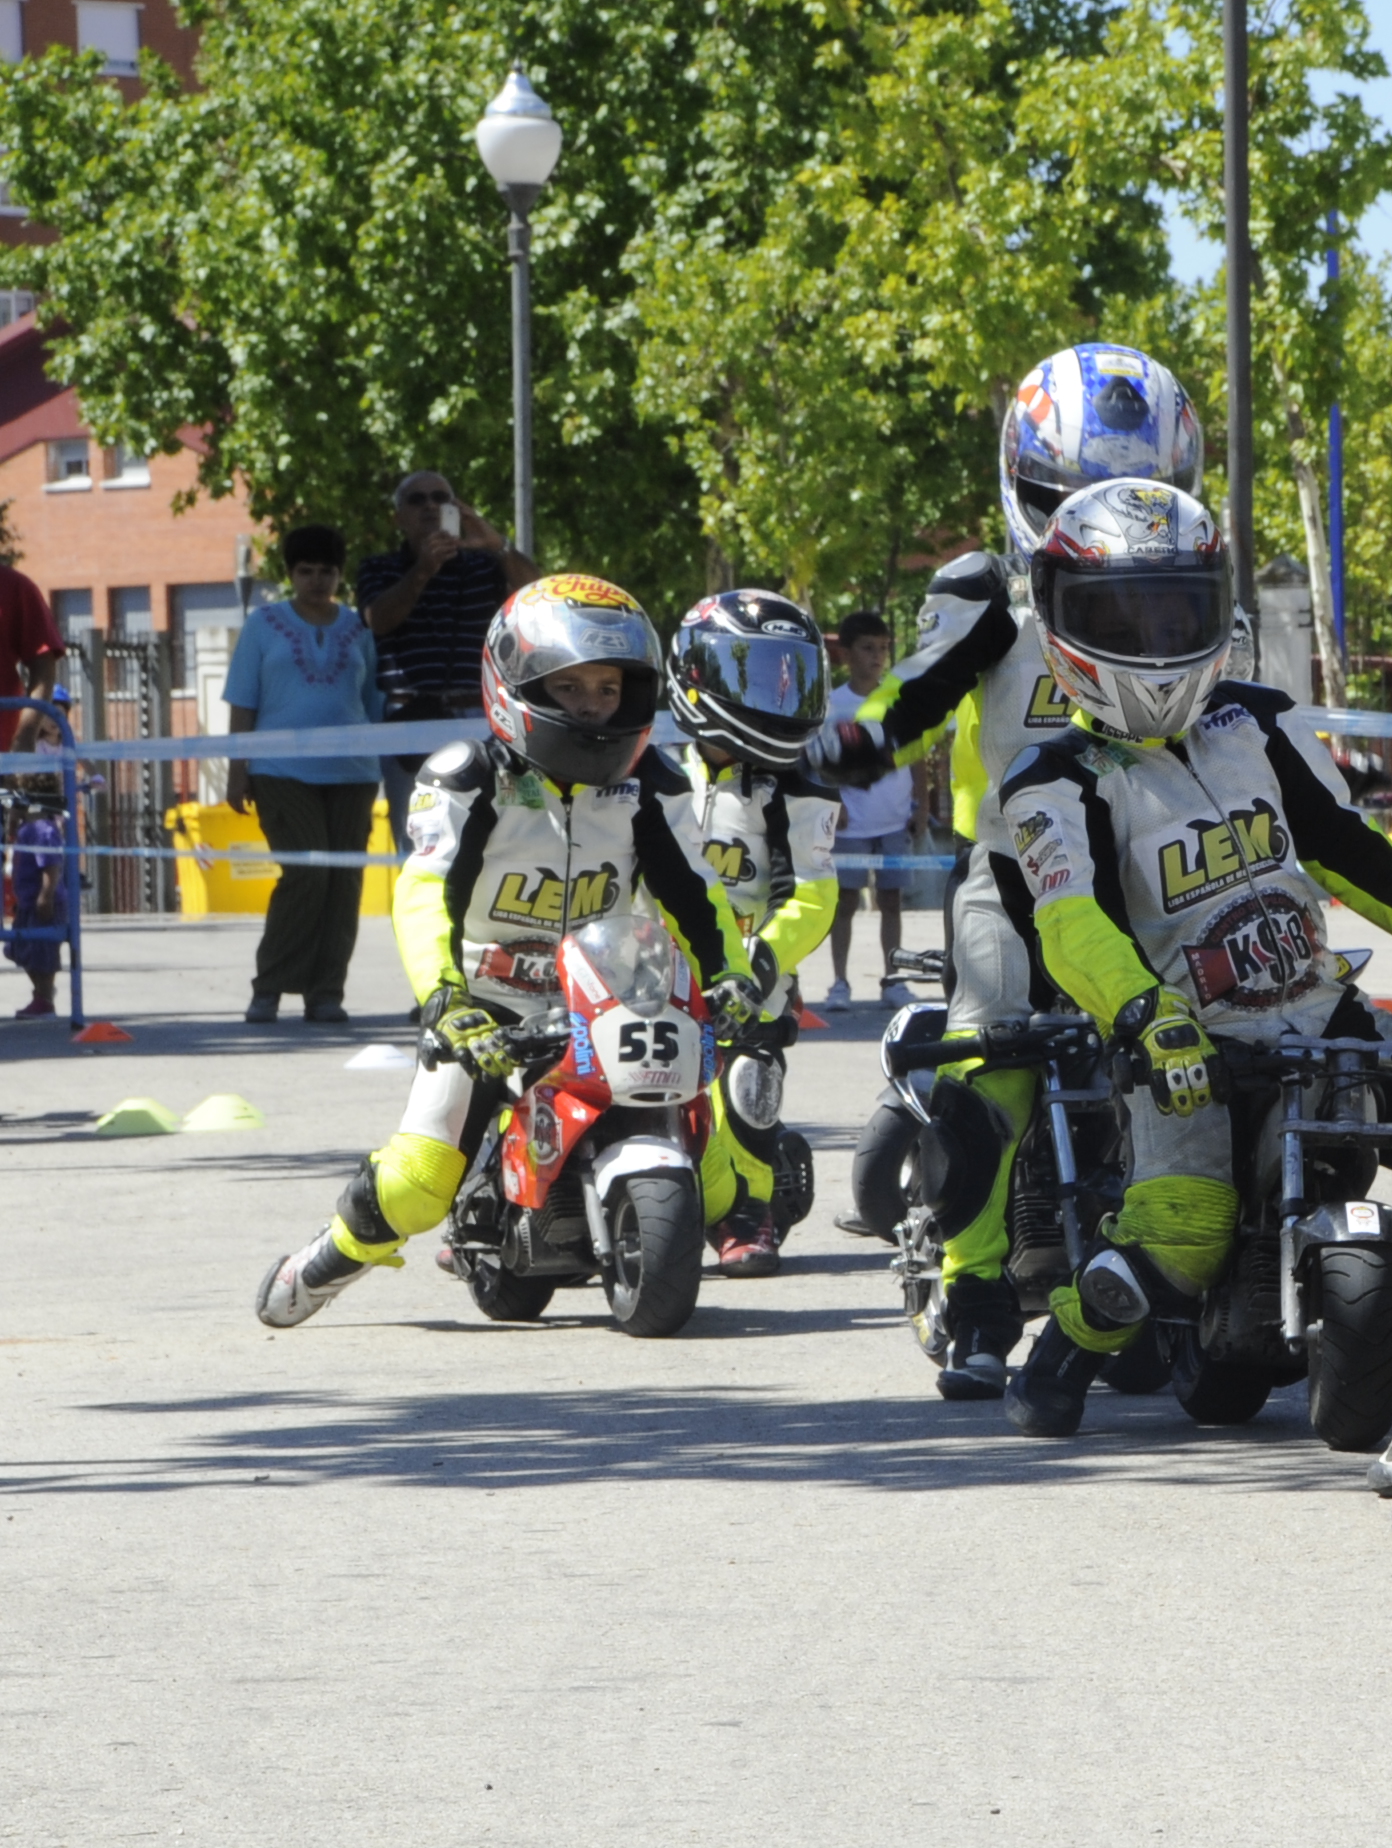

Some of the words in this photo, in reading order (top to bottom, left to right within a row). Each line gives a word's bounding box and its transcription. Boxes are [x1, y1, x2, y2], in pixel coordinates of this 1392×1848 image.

[494, 871, 610, 922] LEM
[1224, 911, 1313, 985] KSB
[570, 1027, 598, 1076] polini
[618, 1021, 680, 1063] 55
